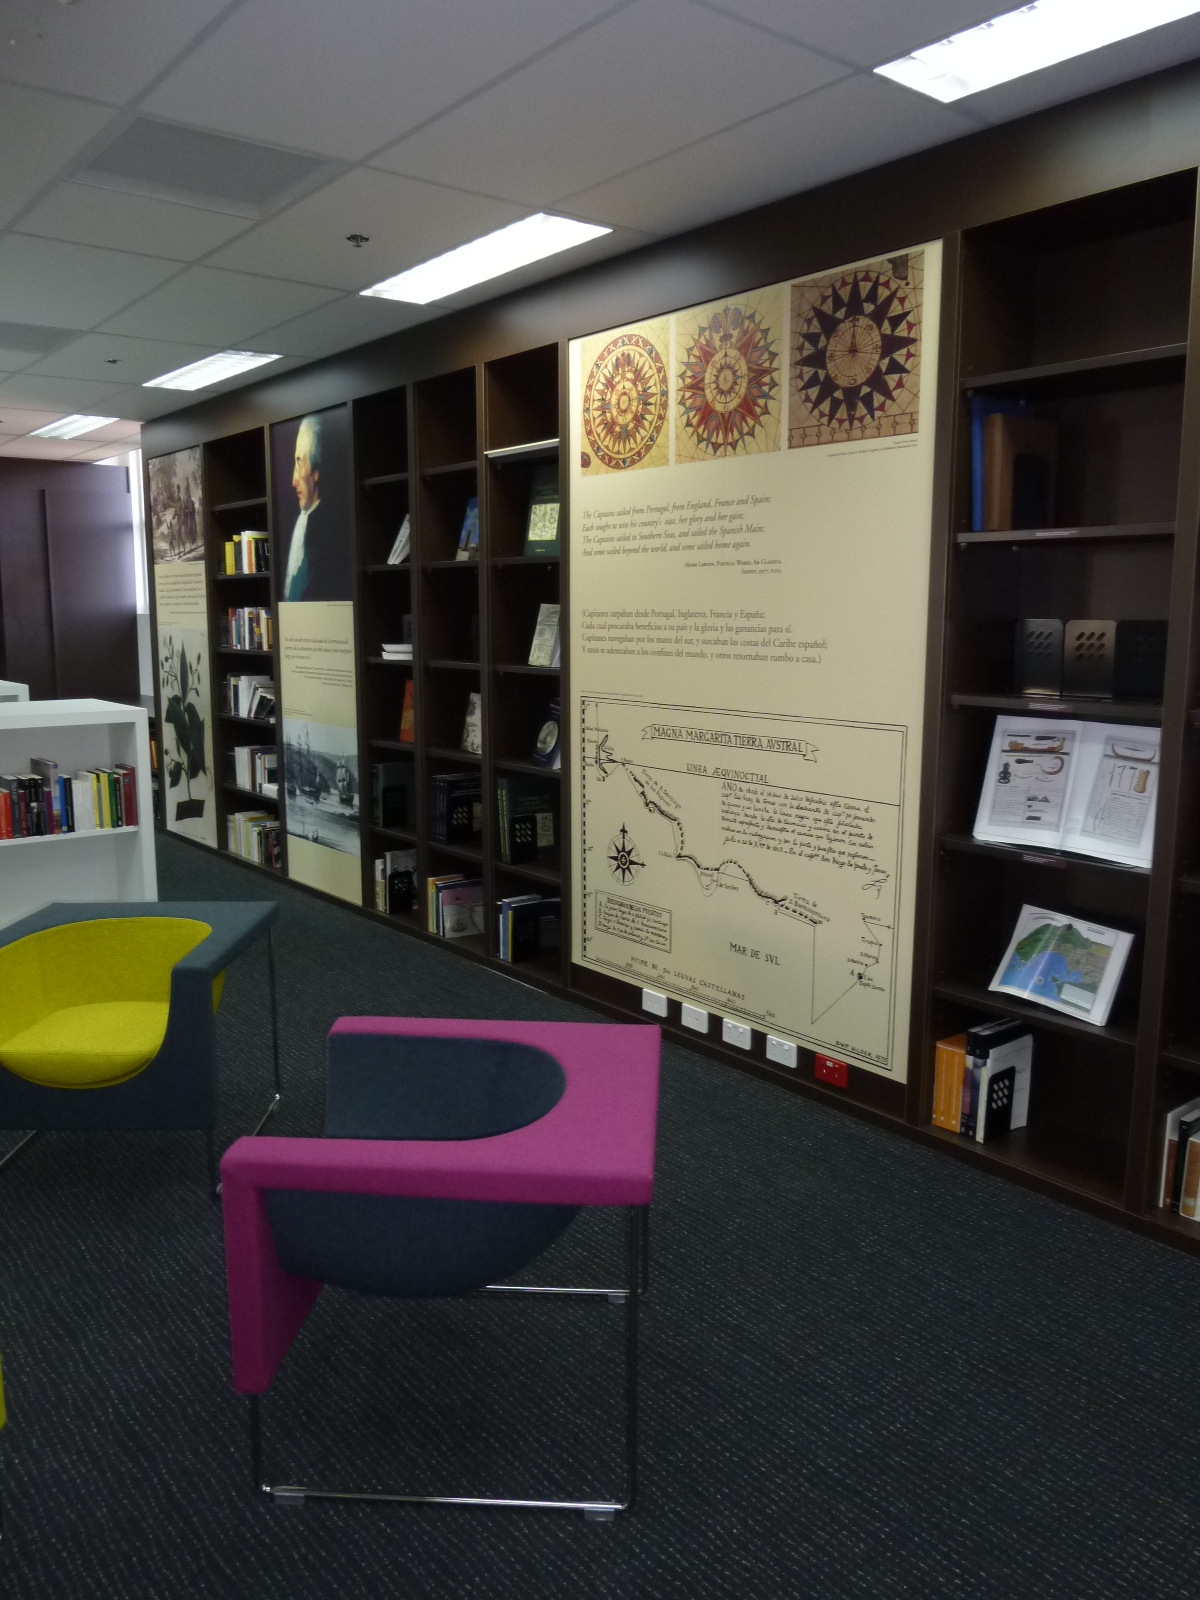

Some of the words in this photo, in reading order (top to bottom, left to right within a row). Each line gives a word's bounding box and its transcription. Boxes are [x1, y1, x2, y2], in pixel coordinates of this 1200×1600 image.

[583, 511, 592, 519] The
[593, 510, 615, 520] Captains
[616, 507, 631, 516] sailed
[631, 506, 645, 517] from
[646, 503, 670, 515] Portugal,
[671, 502, 685, 514] from
[714, 498, 735, 507] France
[736, 495, 750, 506] and
[678, 515, 688, 524] her
[689, 514, 703, 526] glory
[704, 512, 717, 522] and
[717, 512, 728, 521] her
[583, 535, 592, 544] The
[593, 535, 616, 546] Captains
[616, 532, 631, 542] sailed
[638, 531, 662, 541] Southern
[678, 527, 690, 538] and
[690, 526, 708, 537] sailed
[708, 526, 718, 535] the
[719, 524, 744, 538] Spanish
[582, 547, 593, 557] And
[606, 546, 621, 555] sailed
[622, 545, 641, 557] beyond
[641, 545, 650, 553] the
[669, 542, 681, 552] and
[696, 540, 714, 550] sailed
[714, 540, 731, 549] home
[610, 609, 633, 620] zarpaban
[634, 609, 650, 618] desde
[709, 609, 732, 618] Francia
[740, 609, 765, 621] España;
[582, 621, 595, 630] Cada
[596, 621, 607, 630] cual
[608, 622, 634, 632] procuraba
[635, 621, 662, 631] beneficios
[676, 622, 688, 633] país
[694, 622, 700, 631] la
[700, 622, 719, 634] gloria
[726, 623, 734, 632] las
[735, 624, 767, 635] ganancias
[768, 626, 783, 635] para
[581, 633, 606, 643] Capitanes
[608, 634, 635, 644] navegaban
[636, 637, 646, 645] por
[647, 634, 655, 643] los
[673, 635, 683, 644] del
[684, 638, 695, 646] sur,
[701, 636, 728, 646] surcaban
[729, 636, 738, 646] las
[740, 638, 759, 647] costas
[760, 637, 771, 647] del
[773, 638, 797, 648] Caribe
[798, 639, 828, 651] español;
[606, 646, 635, 656] adentraban
[641, 647, 649, 656] los
[650, 648, 673, 657] confines
[674, 649, 684, 657] del
[685, 650, 709, 659] mundo,
[715, 652, 732, 660] otros
[732, 652, 768, 661] retornaban
[770, 653, 794, 662] rumbo
[653, 726, 684, 739] MAGNA
[685, 730, 733, 745] MARGARITA
[733, 735, 763, 749] TIERRA
[765, 739, 804, 753] AVSTRAL
[686, 762, 708, 775] LINEA
[729, 942, 747, 957] MAR
[750, 948, 761, 960] DE
[764, 953, 781, 966] SVL
